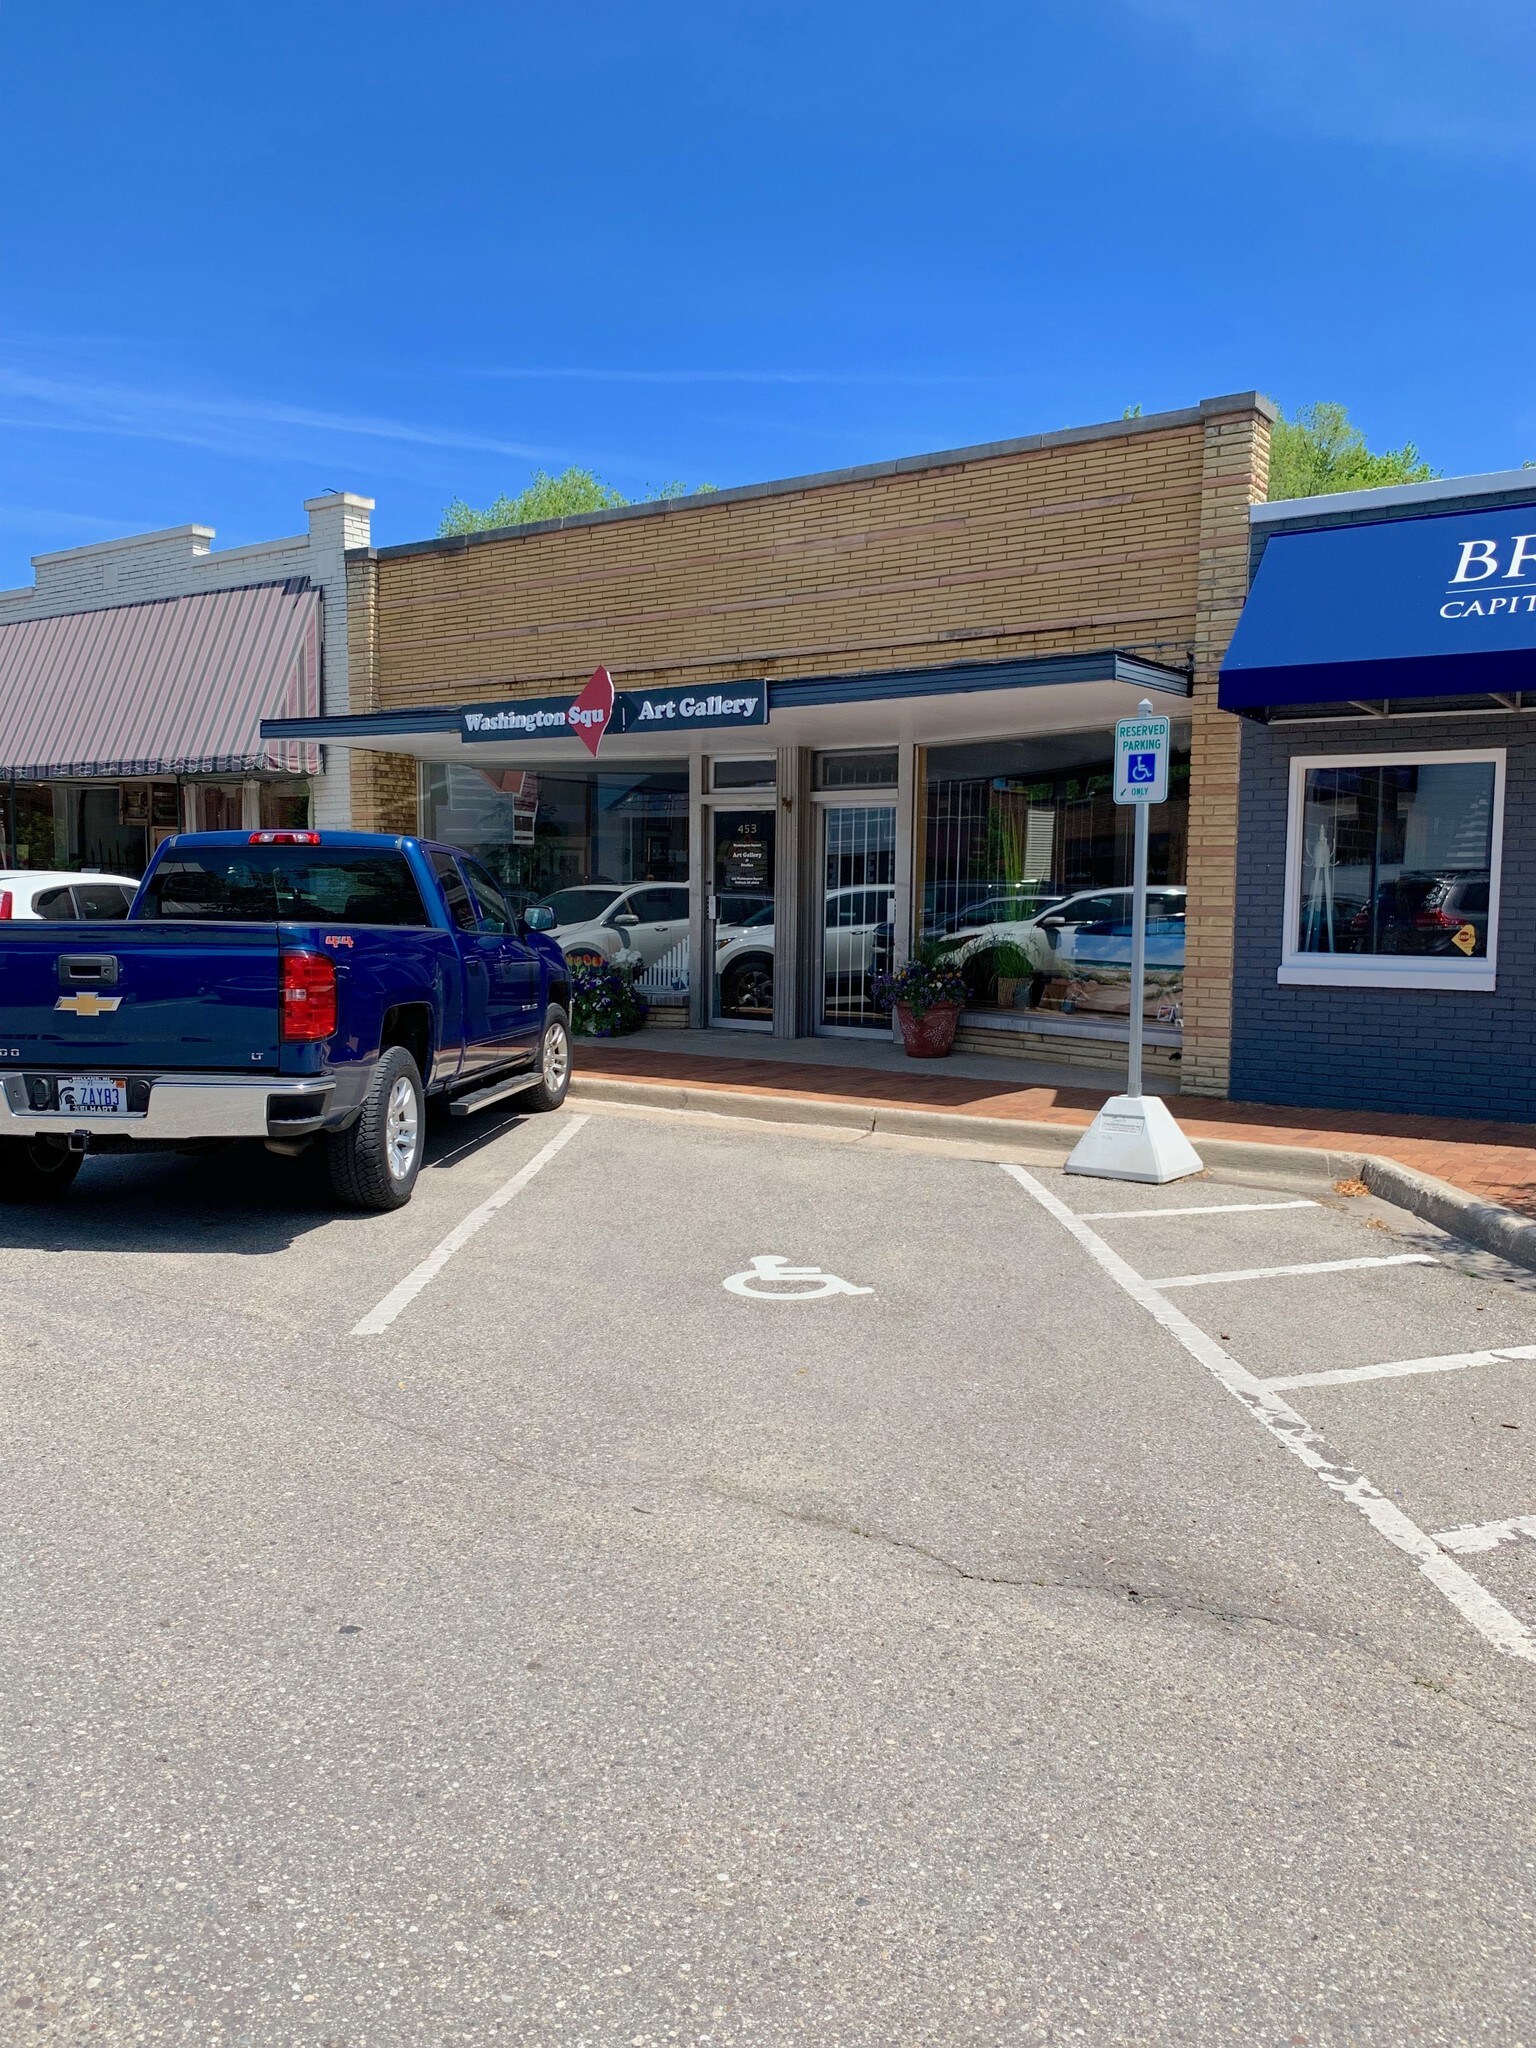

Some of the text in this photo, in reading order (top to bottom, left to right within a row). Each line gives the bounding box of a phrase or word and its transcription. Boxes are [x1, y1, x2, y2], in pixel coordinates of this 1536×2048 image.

[464, 710, 566, 732] Washington
[638, 700, 676, 720] Art
[679, 695, 759, 718] Gallery
[1120, 724, 1166, 738] RESERVED
[1123, 739, 1161, 752] PARKING
[1131, 787, 1149, 796] ONLY
[737, 824, 757, 834] 453
[251, 1052, 265, 1060] LT
